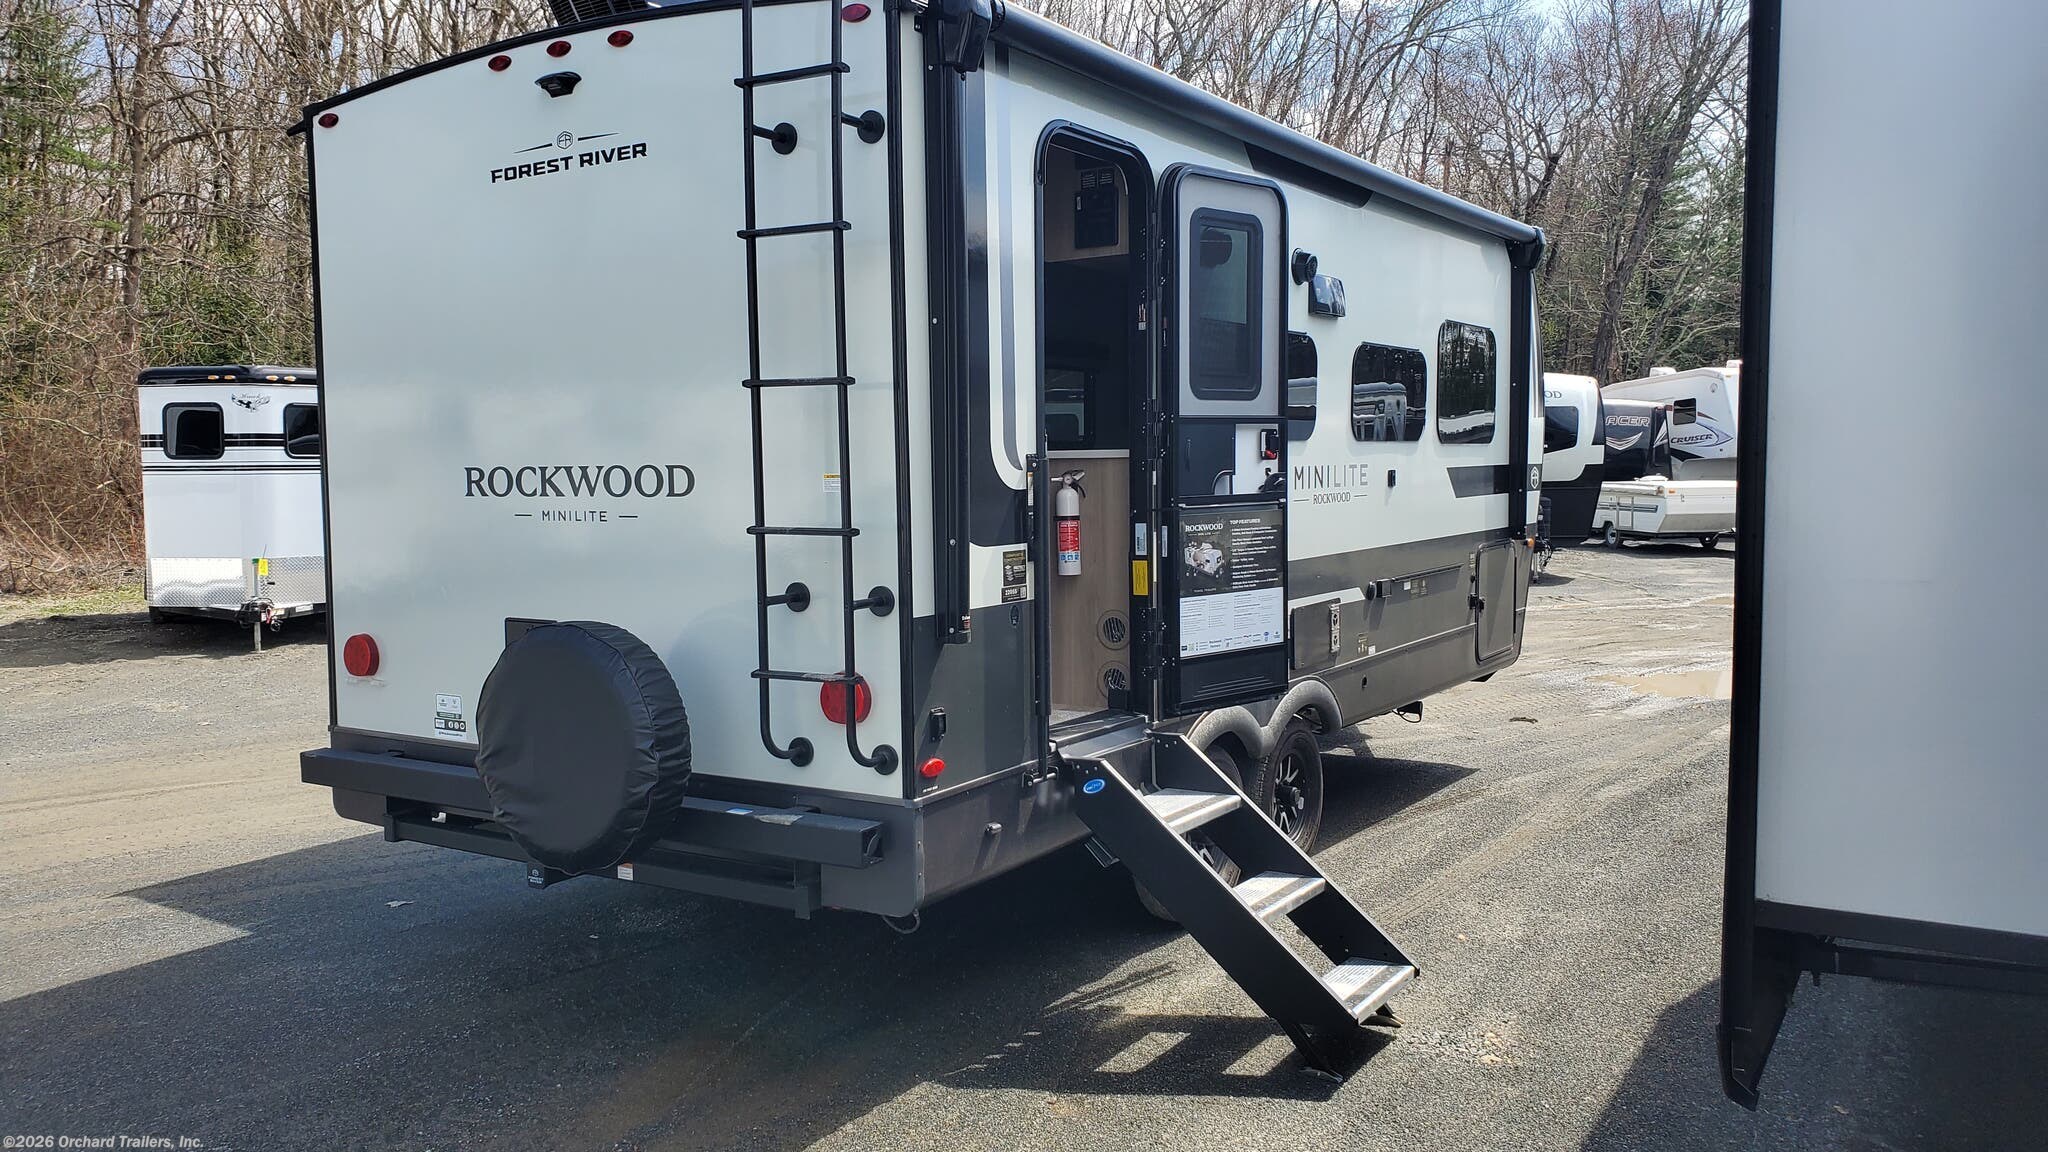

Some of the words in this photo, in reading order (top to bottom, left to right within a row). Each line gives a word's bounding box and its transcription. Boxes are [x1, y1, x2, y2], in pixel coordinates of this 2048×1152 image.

[490, 155, 574, 183] FOREST
[578, 142, 648, 168] RIVER
[1670, 433, 1713, 444] CRUISER
[464, 464, 696, 498] ROCKWOOD
[1294, 464, 1368, 490] MINILITE
[1313, 491, 1351, 504] ROCKWOOD
[541, 510, 608, 522] MINILITE
[1185, 523, 1223, 532] ROCKWOOD
